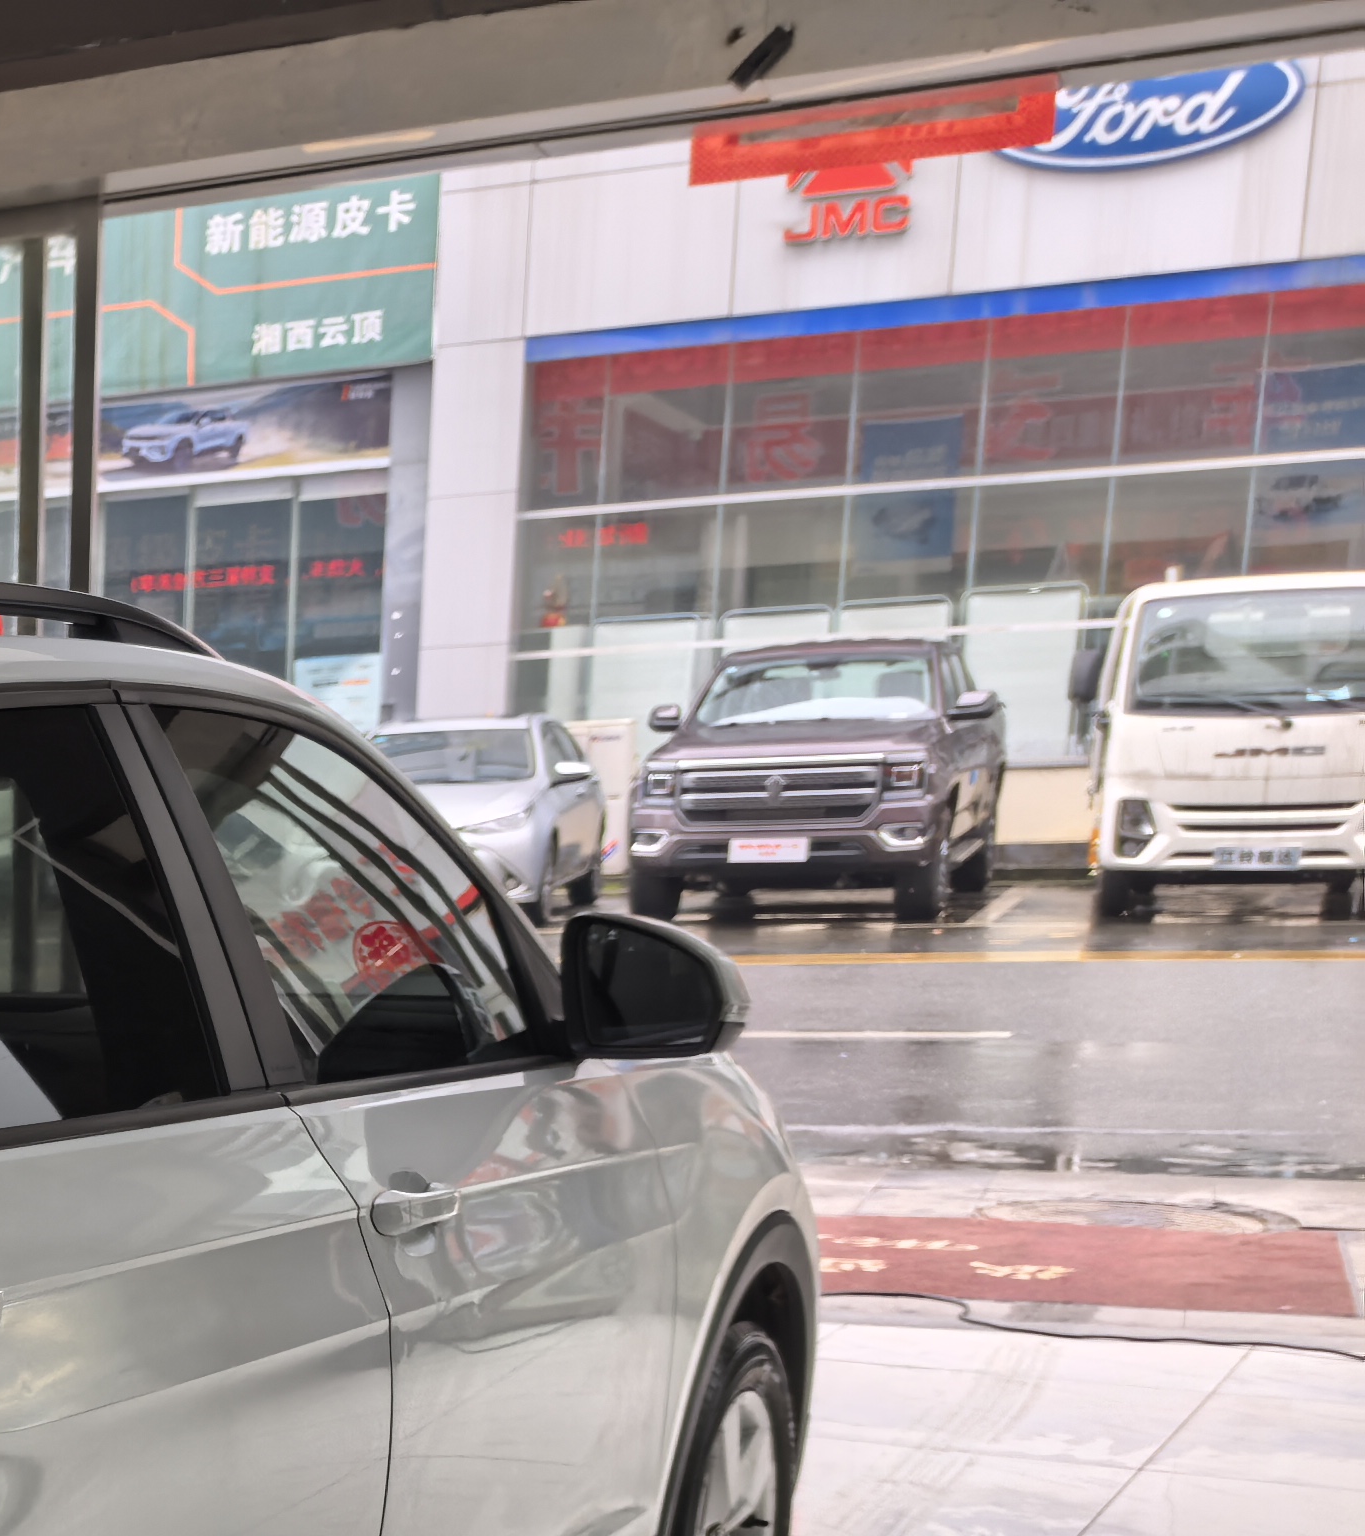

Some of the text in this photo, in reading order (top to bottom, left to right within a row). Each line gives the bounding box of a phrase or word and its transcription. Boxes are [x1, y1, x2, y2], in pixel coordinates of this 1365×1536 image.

[205, 188, 417, 255] 新能源皮卡
[783, 194, 910, 244] JMC
[251, 309, 385, 356] 湘西云顶
